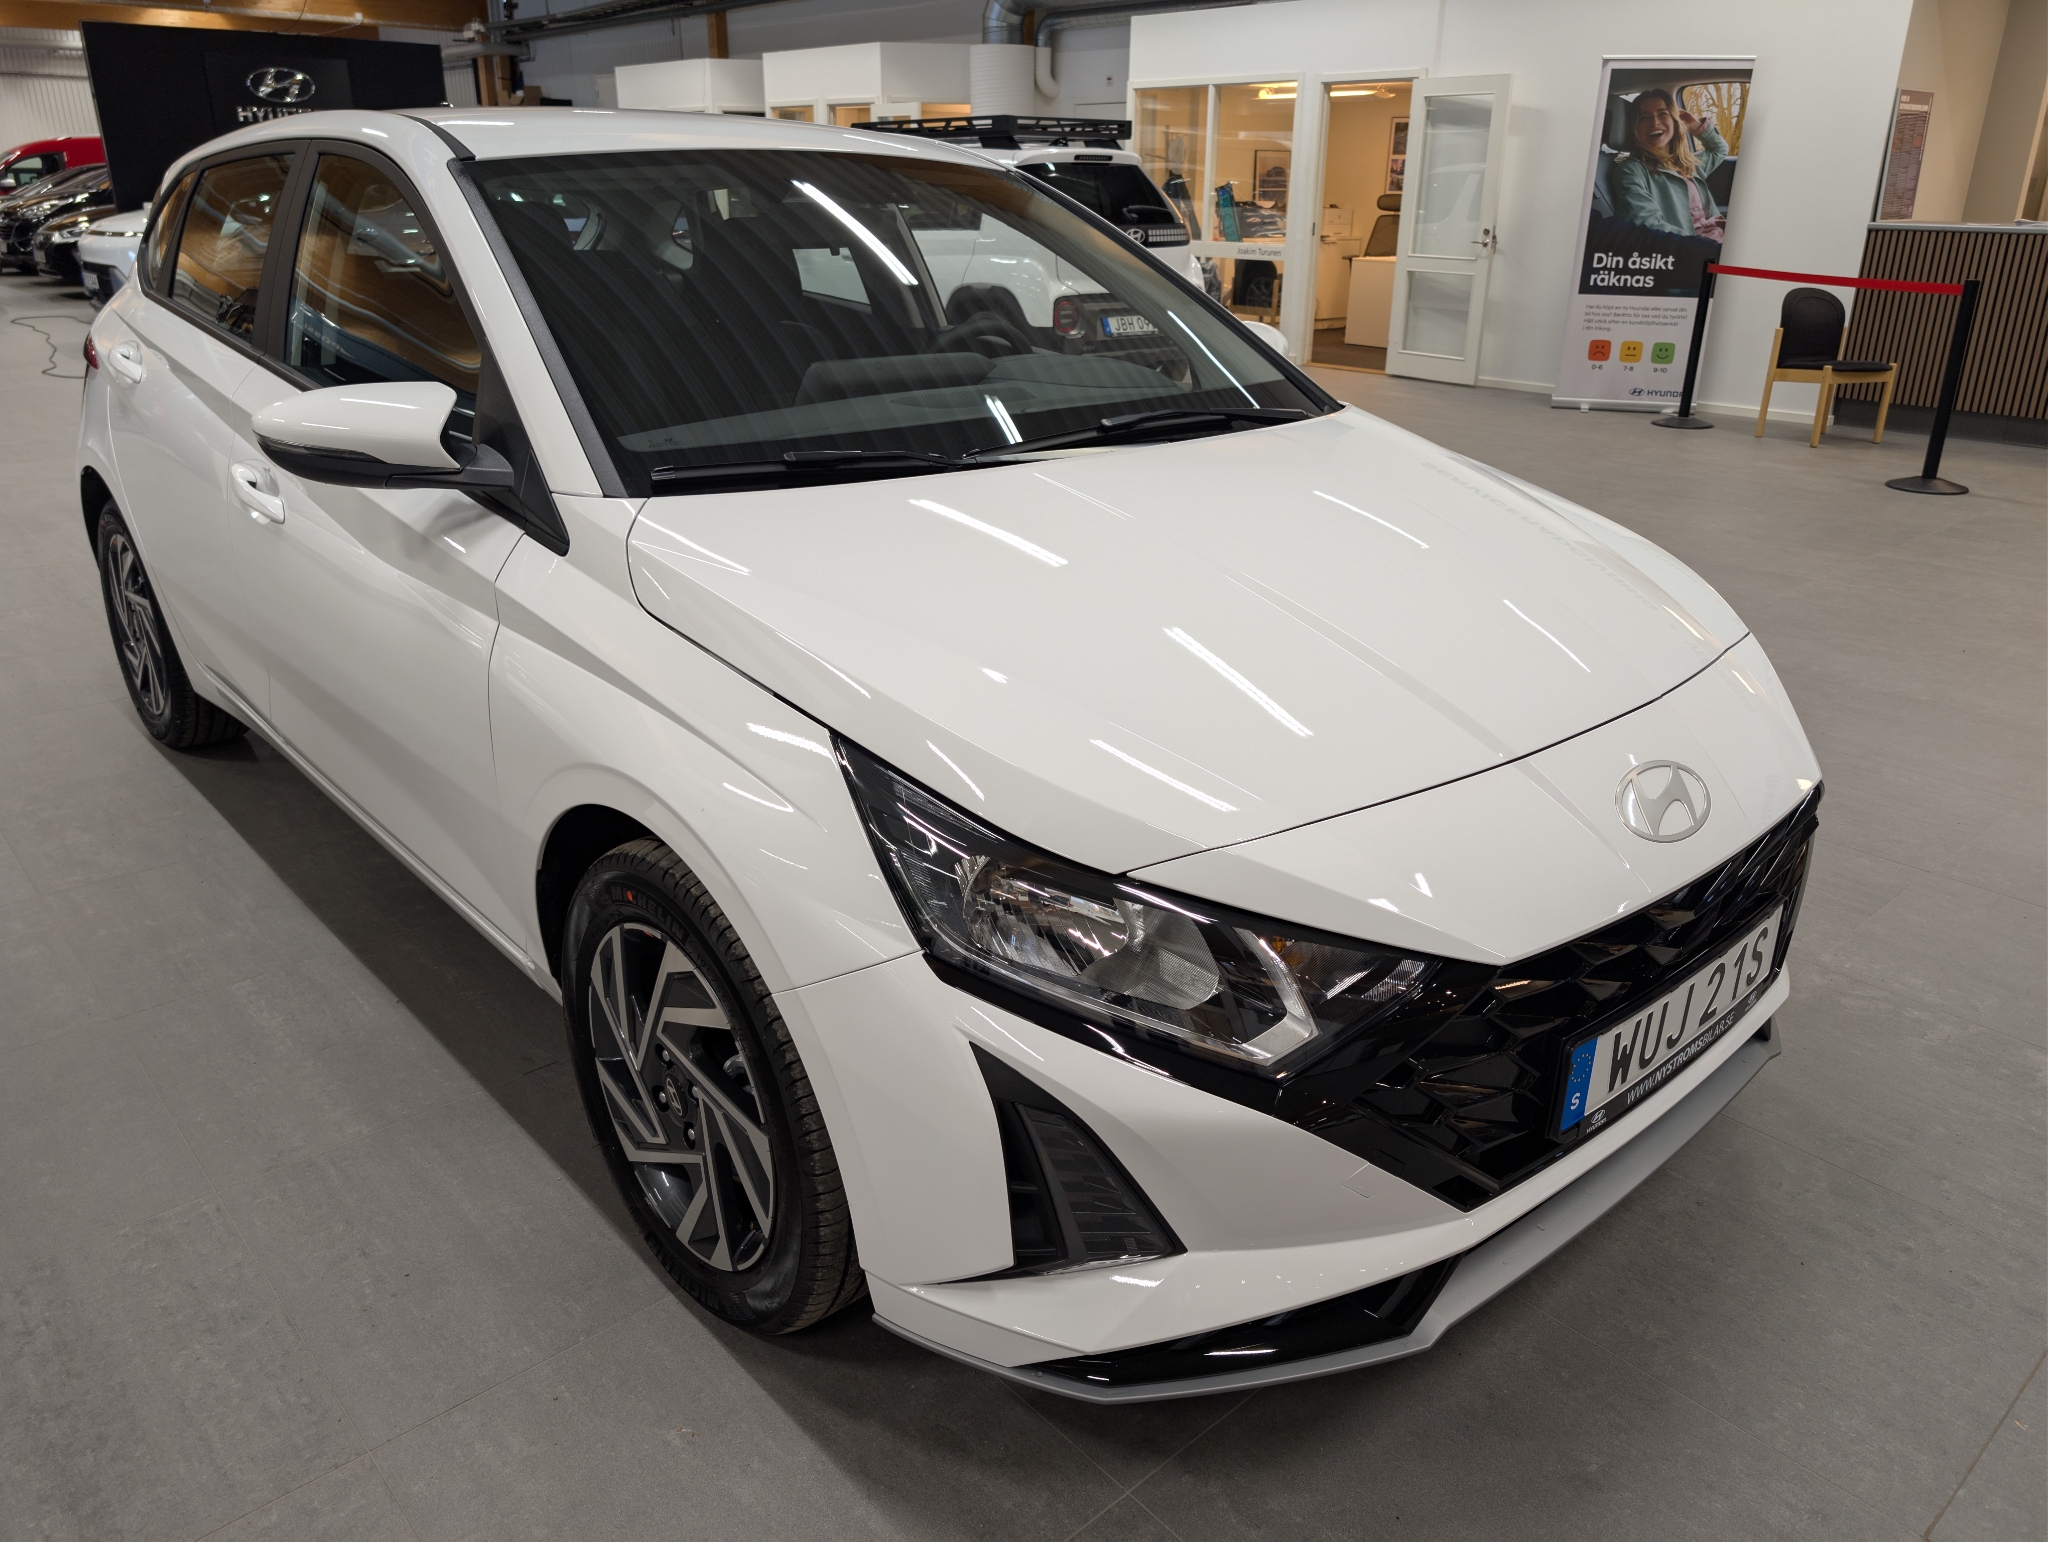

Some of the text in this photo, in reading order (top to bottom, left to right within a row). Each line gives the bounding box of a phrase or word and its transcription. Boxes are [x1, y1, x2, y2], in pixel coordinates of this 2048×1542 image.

[1237, 247, 1282, 257] Joakim Turunen
[1592, 252, 1675, 271] Din åsikt
[1589, 271, 1655, 288] räknas
[1114, 317, 1158, 331] JBH 09
[1608, 926, 1769, 1093] WUJ 21S
[1626, 1011, 1736, 1105] WWW.NYSTROMSBILAR.SE
[1570, 1092, 1581, 1110] S
